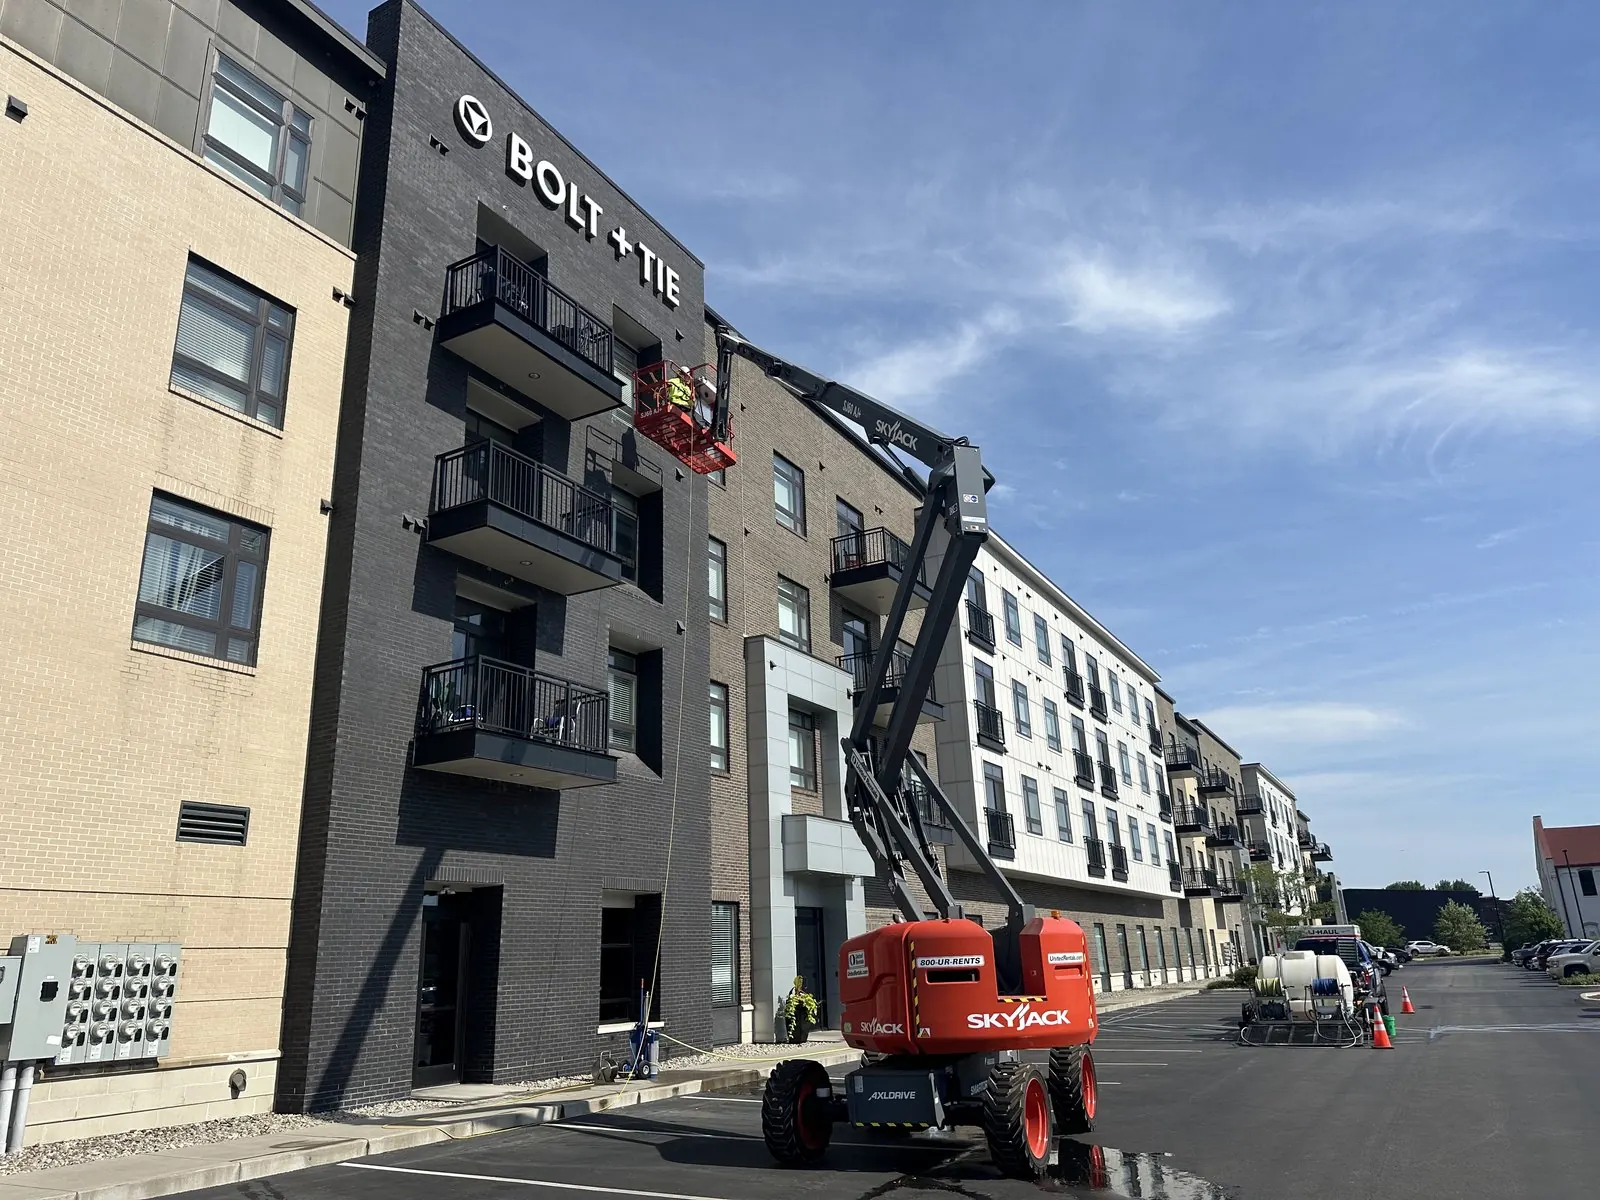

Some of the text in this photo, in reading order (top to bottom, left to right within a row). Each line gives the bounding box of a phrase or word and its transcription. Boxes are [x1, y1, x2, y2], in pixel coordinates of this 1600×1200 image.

[507, 131, 604, 239] BOLT
[637, 241, 680, 308] TIE
[875, 420, 918, 451] SKYJACK
[920, 957, 981, 967] 800-UR-RENTS
[860, 1017, 905, 1035] SKYJACK
[967, 1003, 1071, 1031] SKYJACK
[868, 1091, 916, 1101] AXLDRIVE
